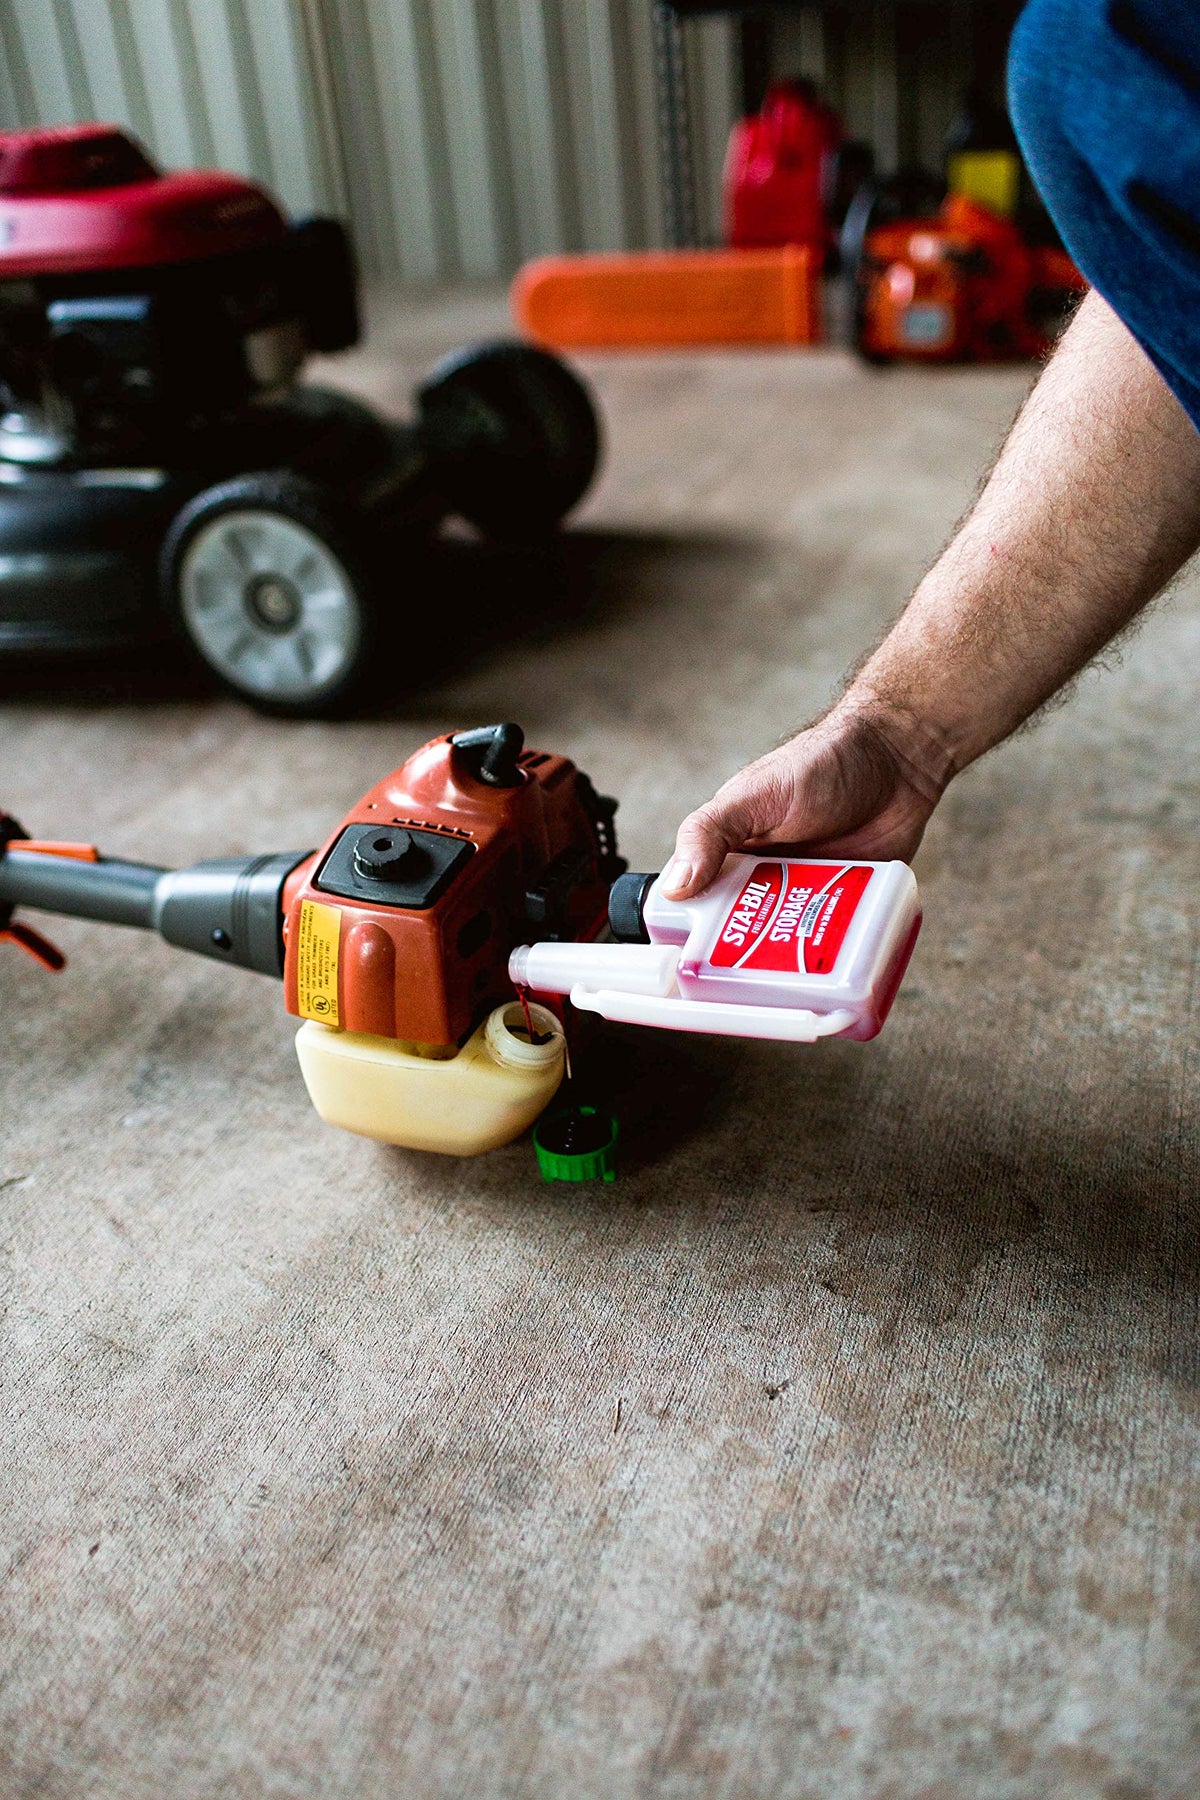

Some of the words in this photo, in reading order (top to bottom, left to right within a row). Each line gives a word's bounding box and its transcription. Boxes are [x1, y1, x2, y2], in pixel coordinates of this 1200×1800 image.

[722, 881, 772, 946] STA-BIL
[751, 921, 763, 934] FUEL
[760, 893, 777, 920] STABILIZER
[769, 887, 813, 943] STORAGE
[315, 1000, 327, 1011] UL
